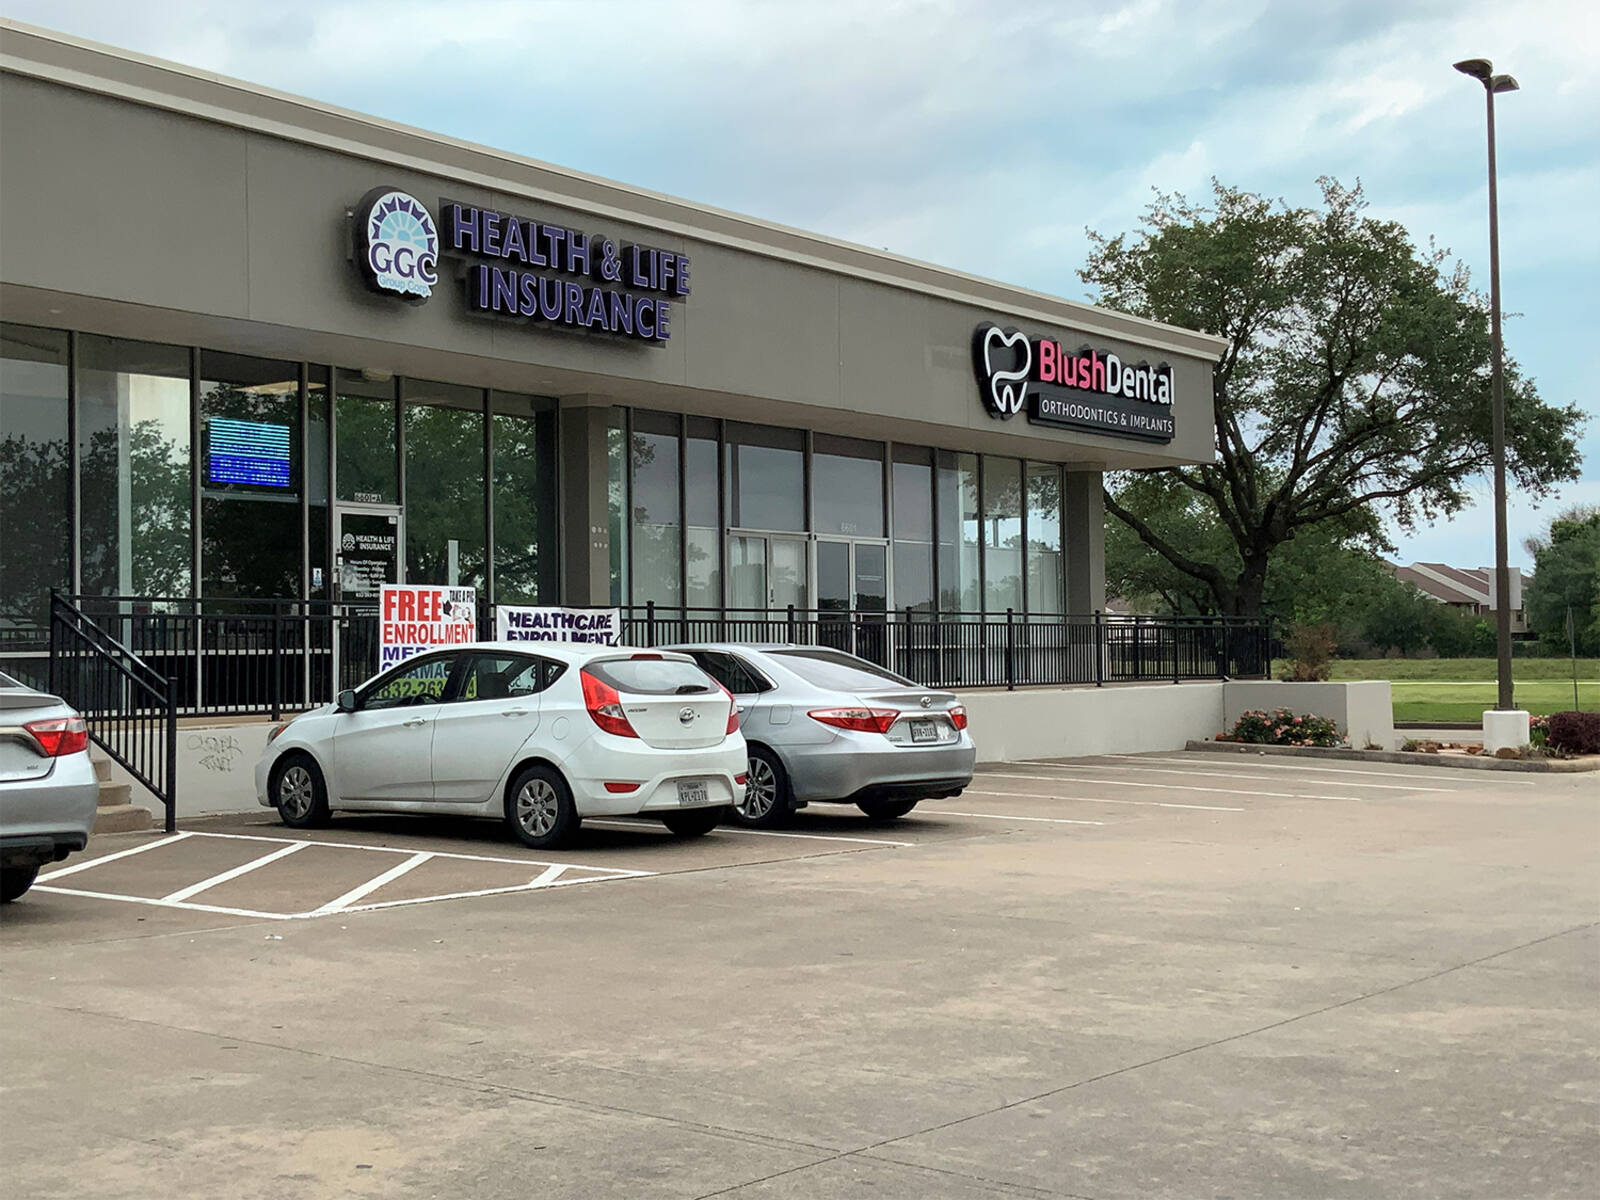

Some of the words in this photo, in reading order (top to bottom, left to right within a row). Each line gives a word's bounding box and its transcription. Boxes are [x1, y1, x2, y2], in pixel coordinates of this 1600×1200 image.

[453, 204, 590, 275] HEALTH
[600, 239, 622, 281] &
[632, 244, 692, 295] LIFE
[370, 242, 438, 284] GGC
[379, 274, 405, 290] Group
[479, 264, 671, 340] INSURANCE
[1041, 399, 1119, 425] ORTHODONTICS
[1120, 414, 1127, 426] &
[1130, 414, 1173, 433] IMPLANTS
[356, 535, 378, 543] HEALTH
[383, 536, 395, 544] LIFE
[359, 543, 392, 551] INSURANCE
[383, 589, 443, 622] FREE
[449, 590, 462, 603] TAKE
[462, 590, 466, 602] A
[508, 612, 612, 630] HEALTHCARE
[383, 623, 474, 644] ENROLLMENT
